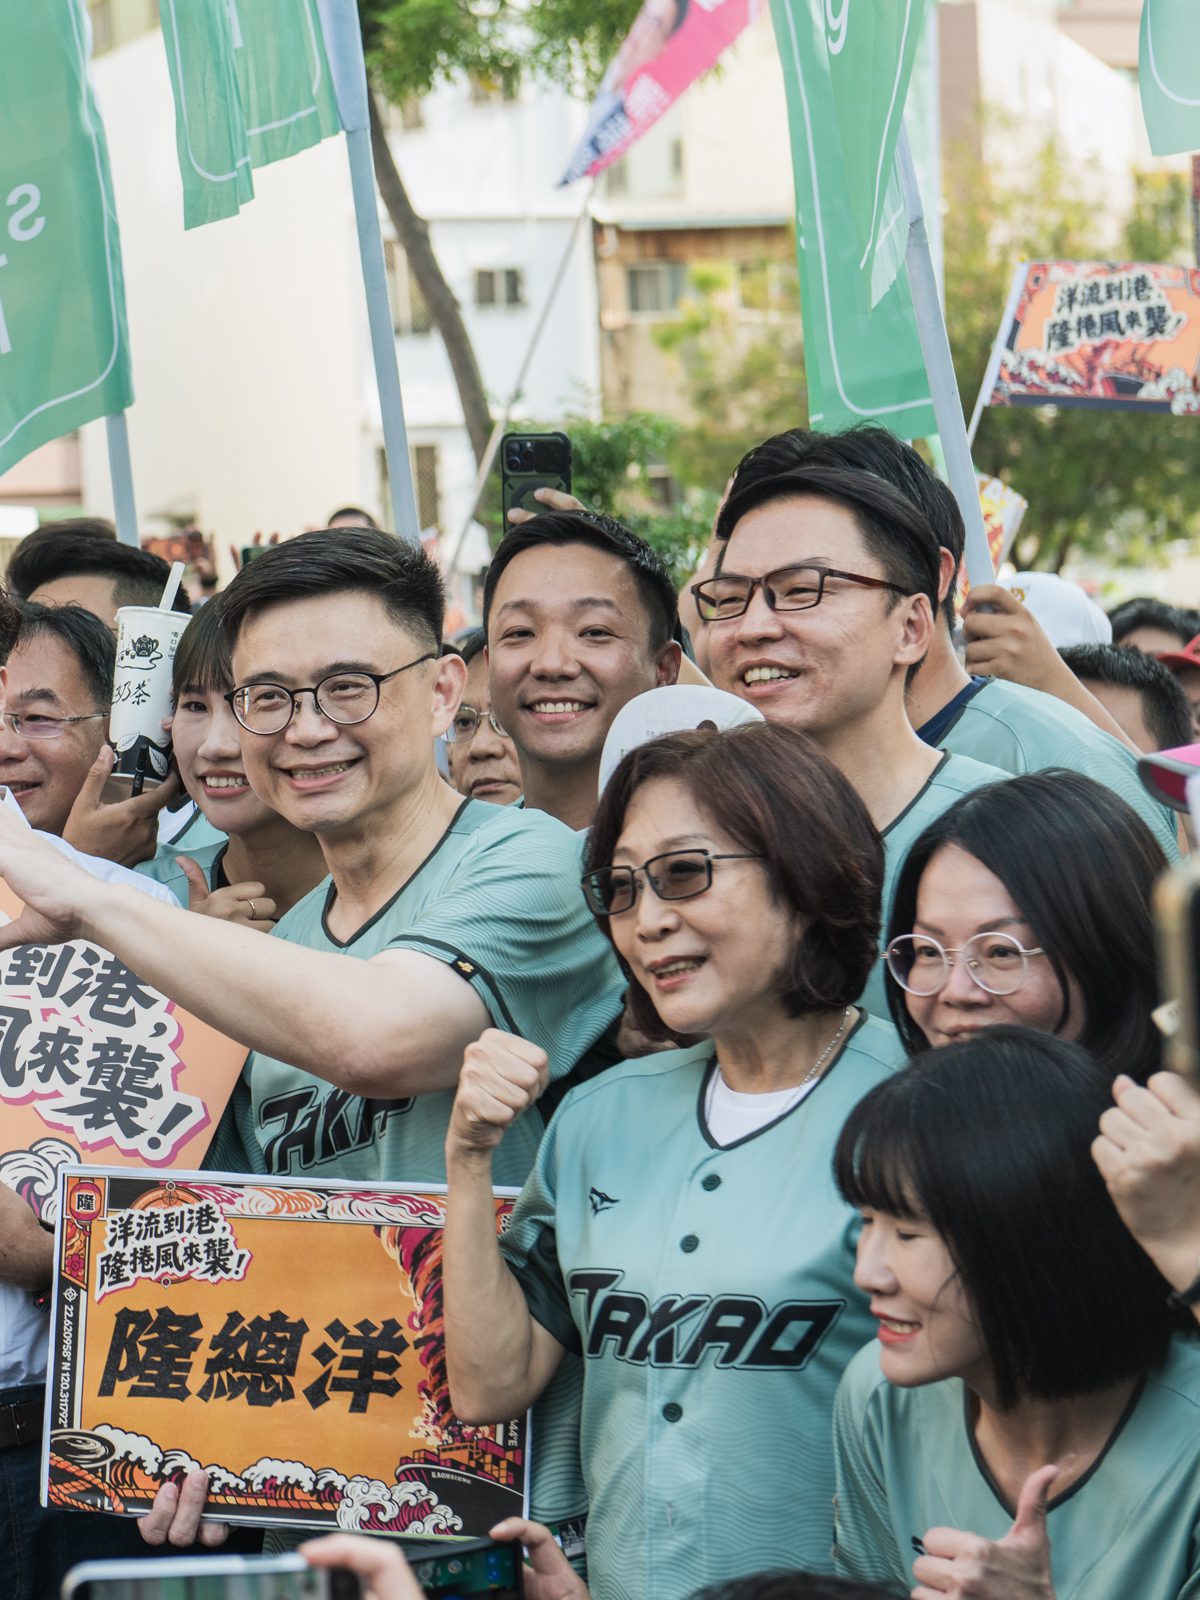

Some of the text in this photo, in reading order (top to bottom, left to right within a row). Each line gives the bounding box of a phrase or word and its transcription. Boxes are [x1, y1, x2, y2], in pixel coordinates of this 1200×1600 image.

[76, 1193, 95, 1211] 隆
[109, 1203, 227, 1249] 洋流到港,
[100, 1237, 246, 1292] 隆捲風來襲!
[569, 1268, 847, 1371] TAKAO
[97, 1306, 410, 1413] 隆總洋
